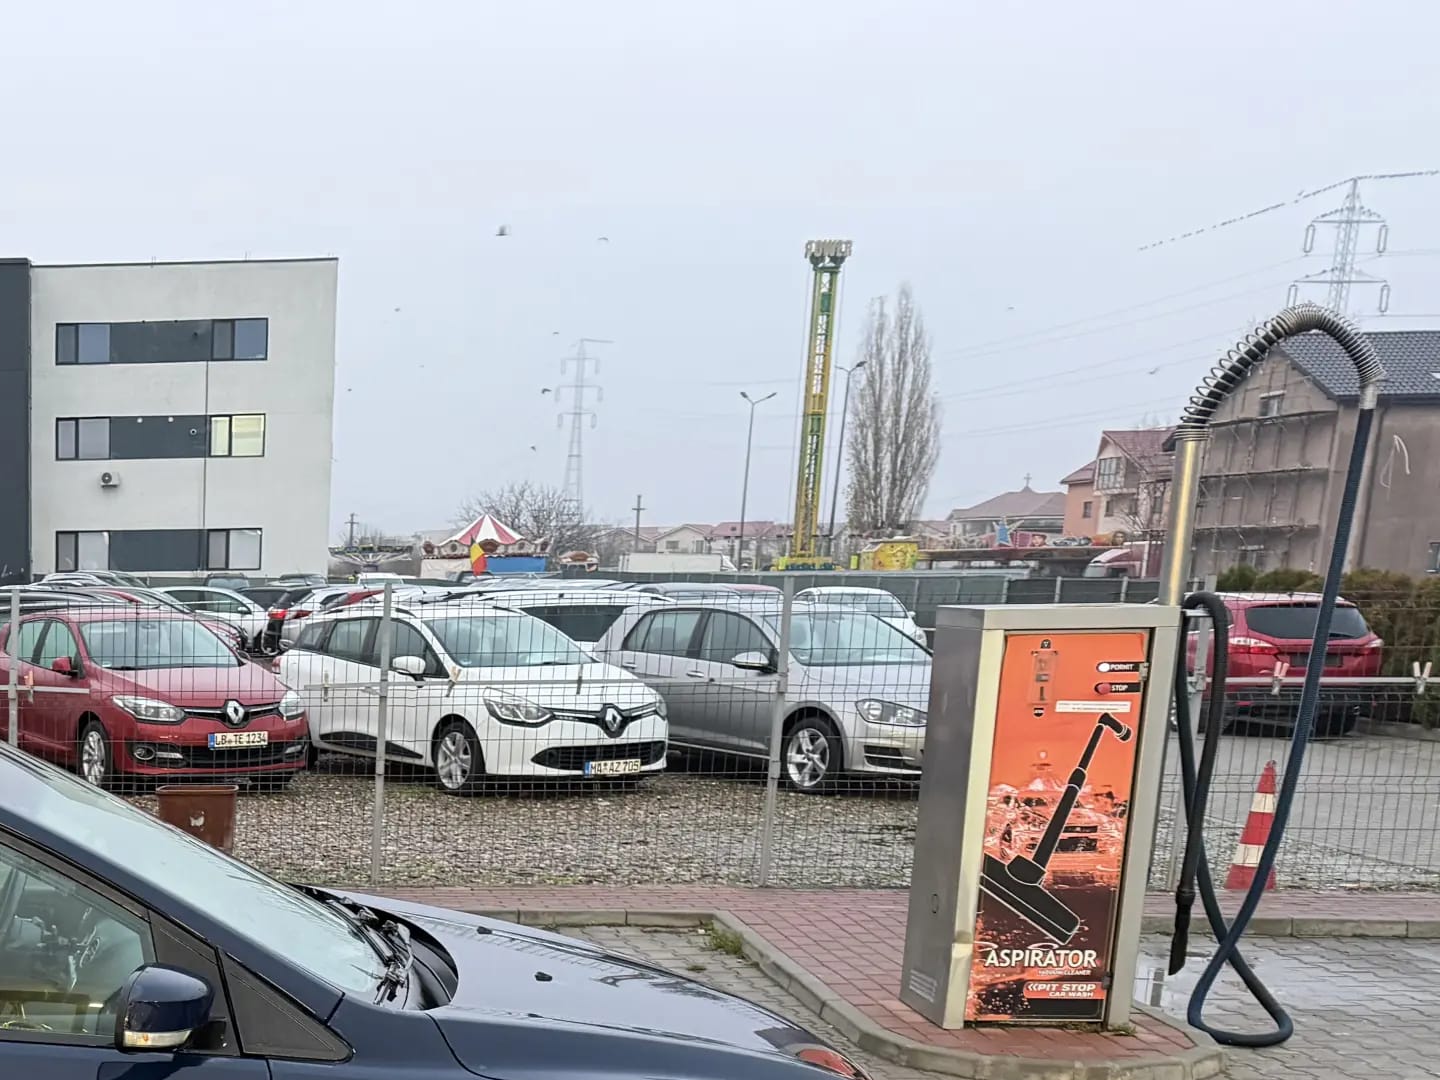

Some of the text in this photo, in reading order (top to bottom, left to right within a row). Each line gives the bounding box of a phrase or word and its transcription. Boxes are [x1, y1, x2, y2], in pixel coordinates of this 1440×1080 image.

[1111, 684, 1129, 692] STOP
[984, 949, 1097, 968] ASPIRATOR
[1037, 983, 1097, 992] PIT STOP
